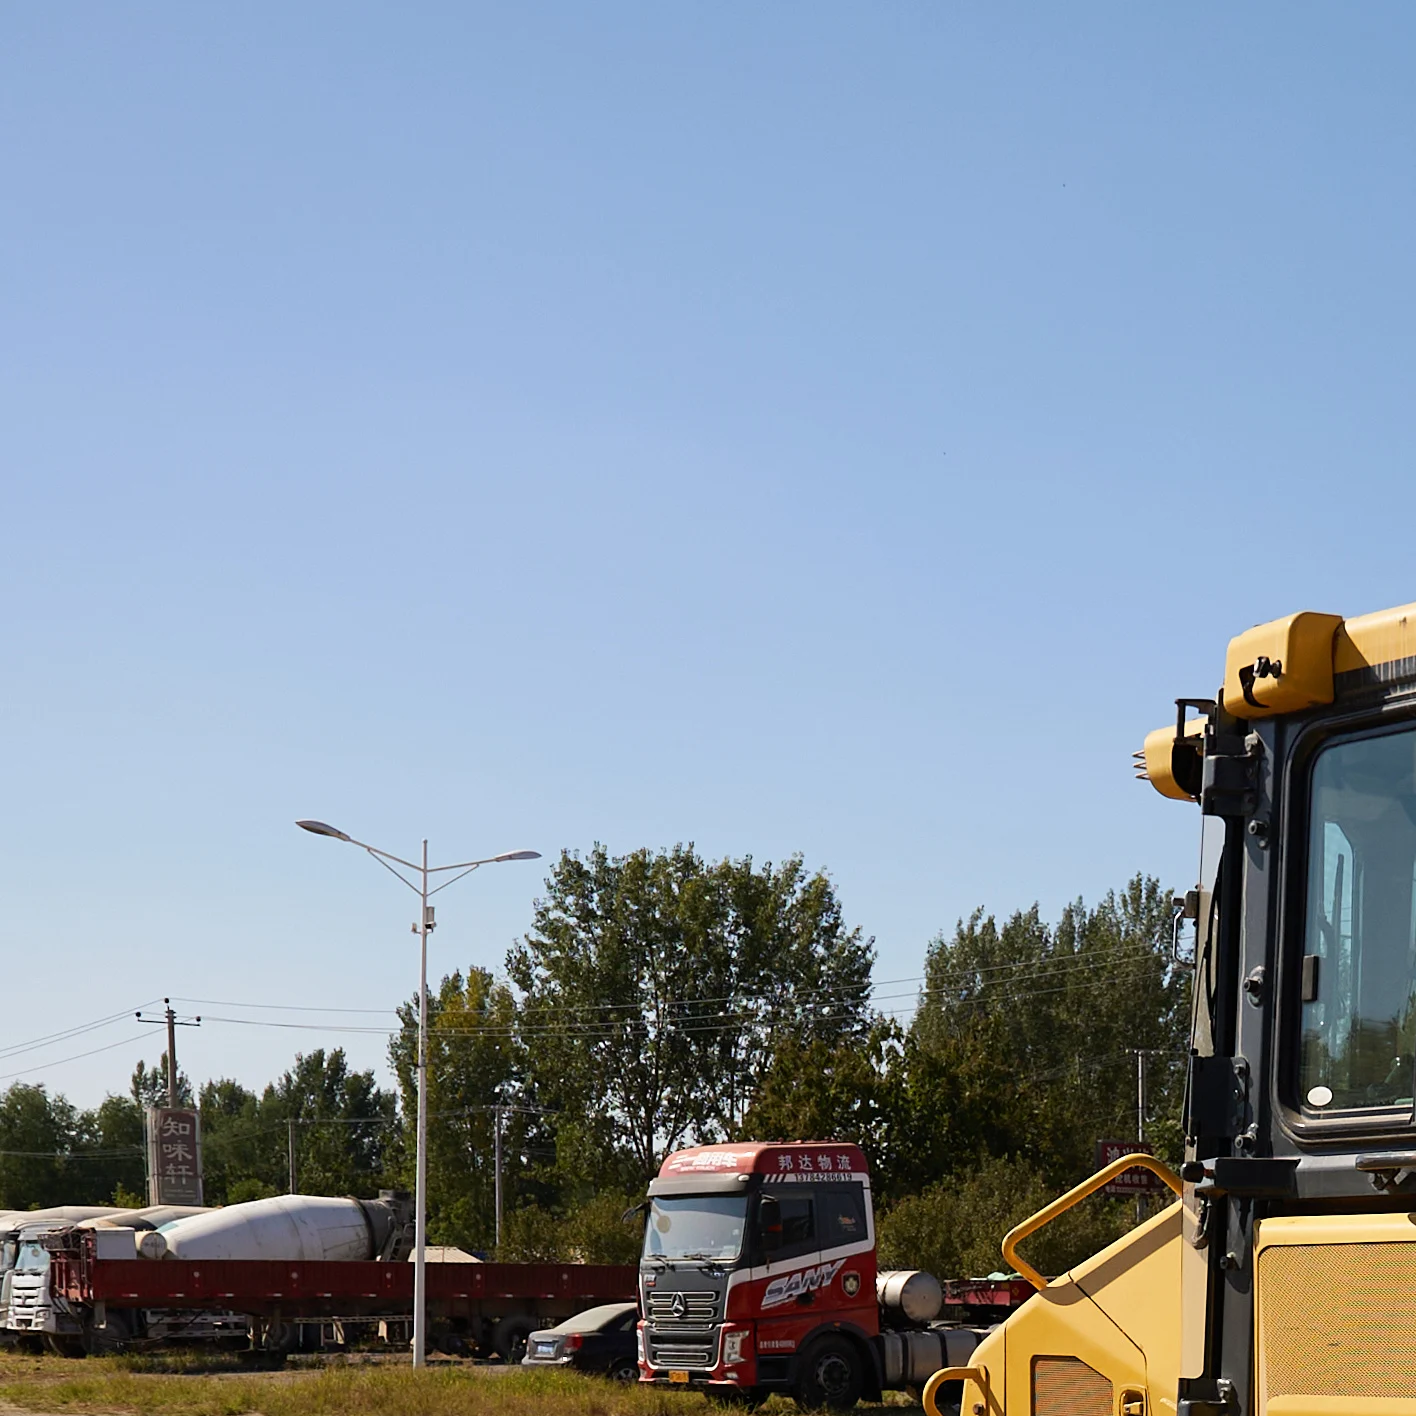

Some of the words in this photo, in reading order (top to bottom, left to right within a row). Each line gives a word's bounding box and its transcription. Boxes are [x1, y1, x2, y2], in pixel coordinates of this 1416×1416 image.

[162, 1116, 193, 1185] 知味轩
[778, 1154, 852, 1171] 邦达物流
[761, 1258, 847, 1309] SANY
